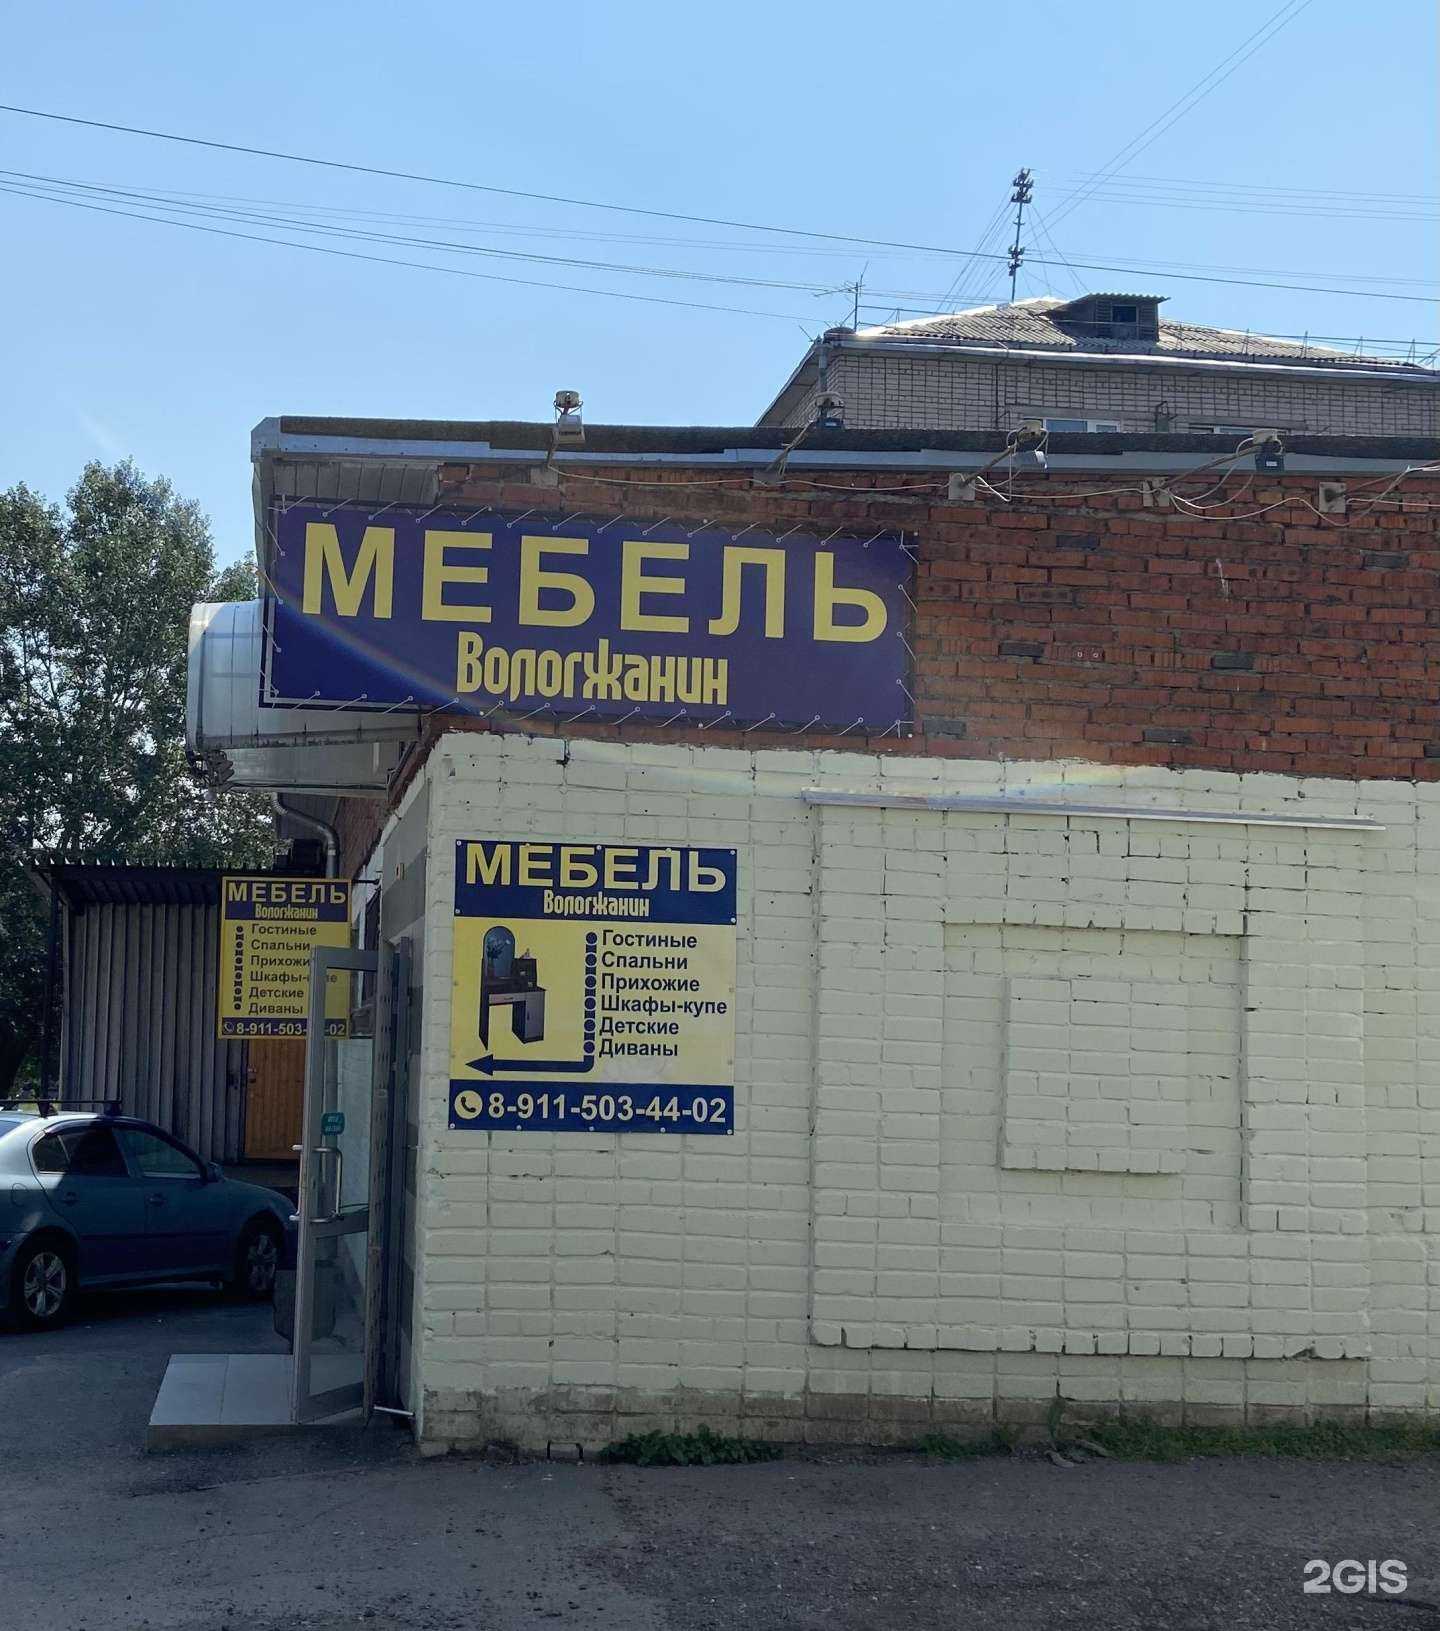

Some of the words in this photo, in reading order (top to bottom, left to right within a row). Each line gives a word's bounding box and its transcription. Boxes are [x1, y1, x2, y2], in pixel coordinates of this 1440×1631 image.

[302, 521, 888, 643] МЕБЕЛЬ
[456, 631, 728, 706] Вологжанин
[466, 842, 727, 893] МЕБЕЛЬ
[227, 882, 347, 904] МЕБЕЛЬ
[255, 903, 318, 920] Вологжанин
[543, 889, 650, 917] Вологжанин
[251, 923, 317, 936] Гостиные
[601, 929, 698, 949] Гостиные
[250, 938, 311, 951] Спальни
[250, 955, 311, 969] Прихожи
[601, 951, 689, 970] Спальни
[248, 986, 305, 1000] Детские
[600, 973, 701, 994] Прихожие
[248, 1002, 303, 1016] Диваны
[600, 995, 728, 1018] Шкафы-купе
[236, 1022, 345, 1036] 8-911-503--02
[599, 1017, 680, 1036] Детские
[599, 1038, 679, 1057] Диваны
[488, 1092, 727, 1124] 8-911-503-44-02
